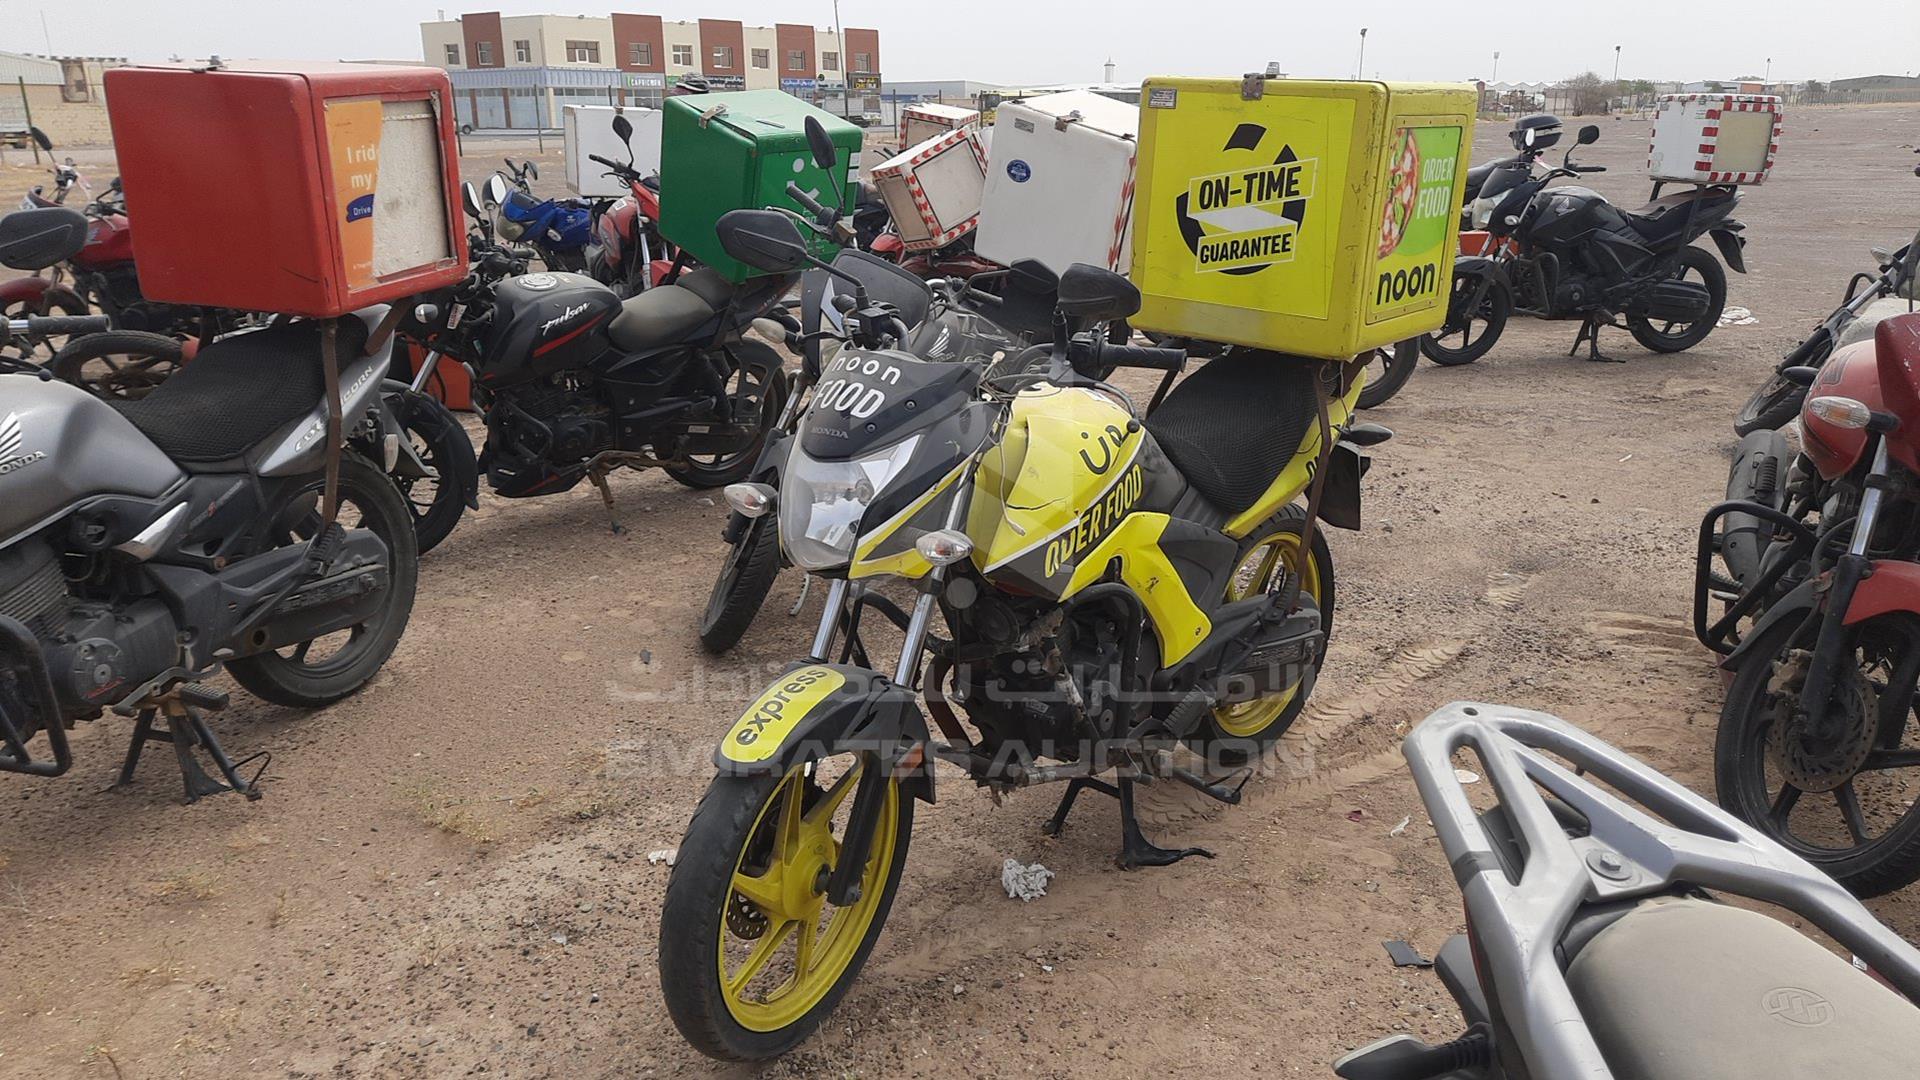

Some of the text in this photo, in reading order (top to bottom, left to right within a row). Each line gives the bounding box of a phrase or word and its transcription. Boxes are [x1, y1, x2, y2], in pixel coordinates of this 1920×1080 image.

[346, 144, 378, 164] I rid
[1422, 157, 1455, 183] ORDER
[351, 173, 372, 190] my
[1199, 166, 1302, 210] ON-TIME
[1416, 186, 1450, 219] FOOD
[1200, 233, 1292, 264] GUARANTEE
[1376, 263, 1435, 305] noon
[341, 366, 374, 405] ICORN
[832, 356, 901, 385] noon
[810, 379, 885, 418] FOOD
[810, 427, 848, 439] HONDA
[0, 451, 46, 474] ONDA
[1105, 464, 1142, 529] FOOD
[736, 670, 827, 745] express
